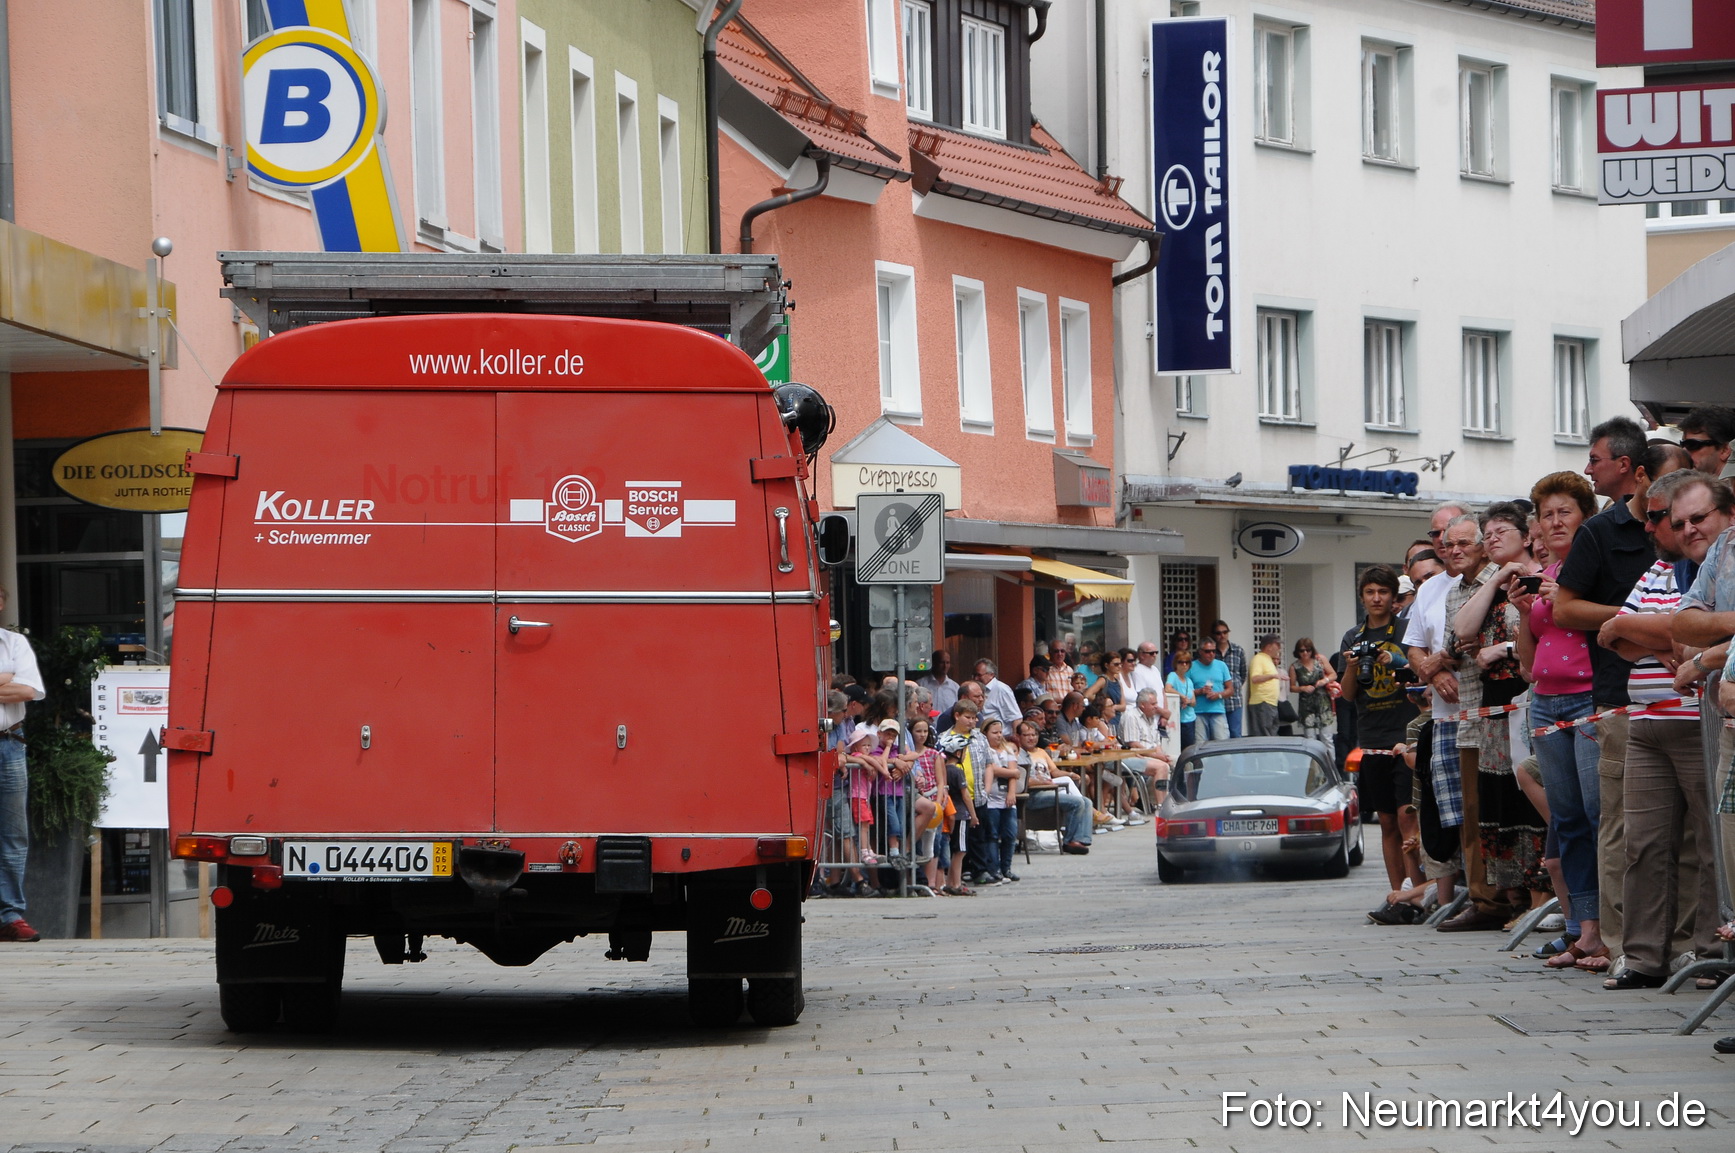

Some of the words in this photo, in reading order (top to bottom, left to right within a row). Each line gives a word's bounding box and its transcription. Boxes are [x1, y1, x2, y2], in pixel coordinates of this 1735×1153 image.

[259, 68, 332, 144] B
[1203, 50, 1223, 214] TAILOR
[1603, 153, 1735, 198] WEID
[1205, 221, 1225, 340] TOM
[408, 348, 585, 376] www.koller.de
[62, 465, 96, 480] DIE
[859, 466, 938, 493] Creppresso
[114, 487, 150, 497] JUTTA
[362, 463, 514, 505] Notruf
[628, 490, 678, 503] BOSCH
[254, 490, 375, 521] KOLLER
[628, 504, 679, 516] Service
[551, 509, 597, 523] Bosch
[557, 523, 591, 533] CLASSIC
[268, 529, 372, 545] Schwemmer
[878, 560, 921, 575] ZONE
[1223, 820, 1240, 832] CHA
[1246, 820, 1258, 831] CF
[1260, 819, 1278, 831] 76H
[435, 846, 448, 854] 26
[288, 846, 306, 872] N
[325, 846, 429, 873] 044406
[435, 855, 448, 863] 06
[435, 864, 448, 872] 12
[247, 922, 300, 945] Metz
[718, 916, 770, 939] Metz
